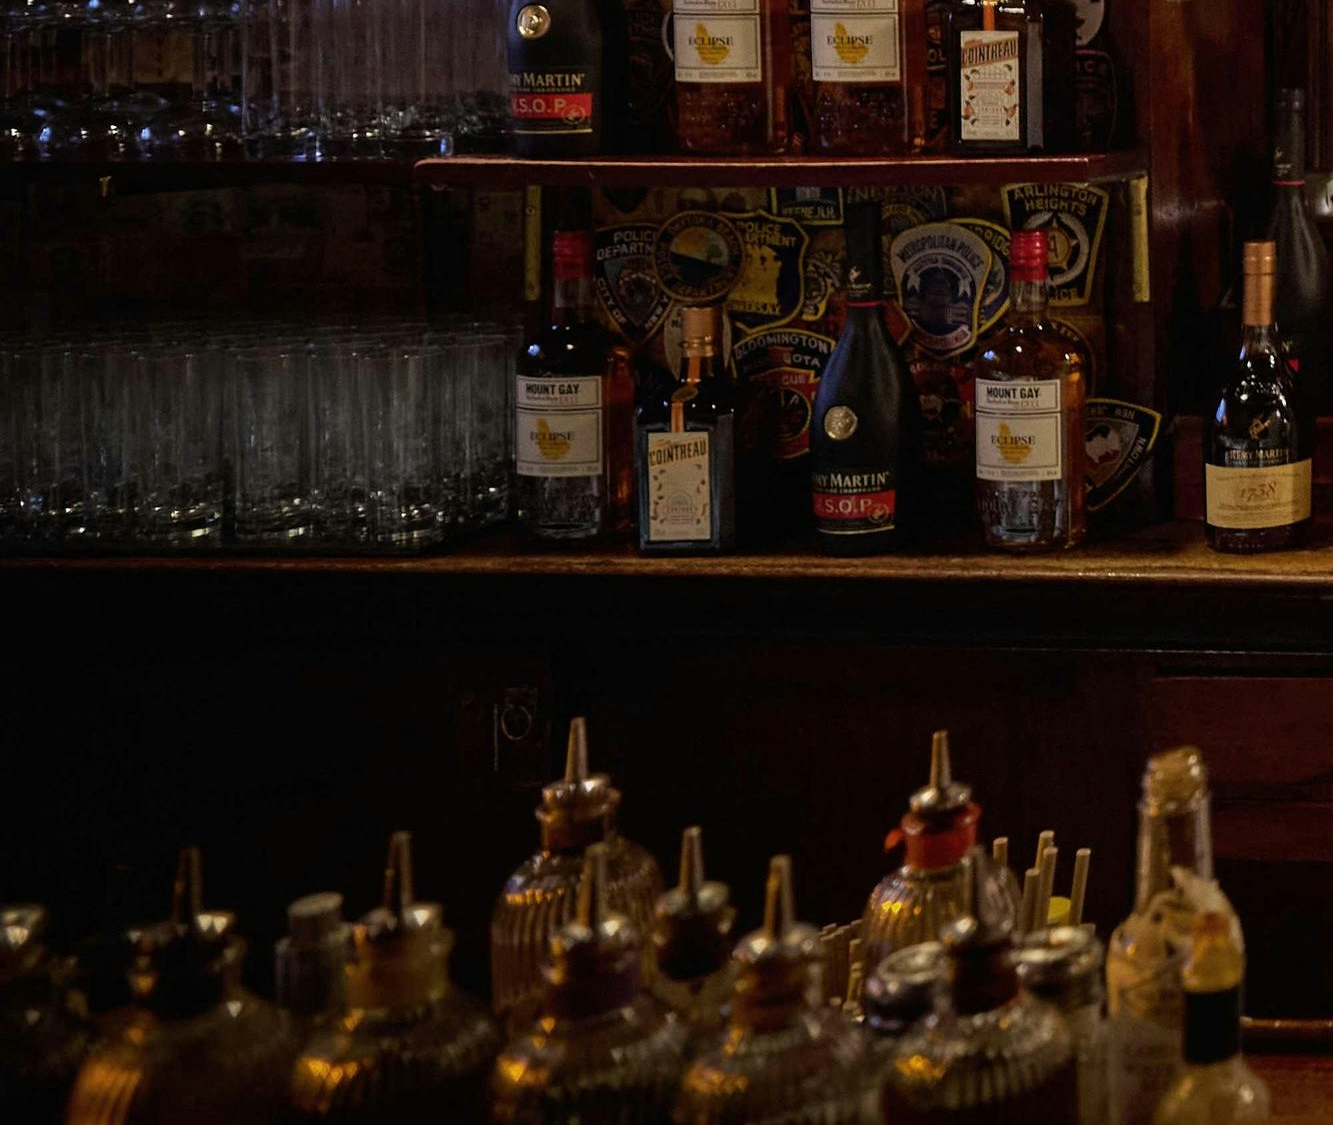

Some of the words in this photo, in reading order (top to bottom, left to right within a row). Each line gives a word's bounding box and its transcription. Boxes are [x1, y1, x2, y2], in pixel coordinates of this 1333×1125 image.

[688, 34, 735, 47] ECLIPSE
[826, 34, 874, 47] ECLIPSE
[961, 40, 1017, 65] COINTREAU
[524, 71, 585, 89] MARTIN
[1013, 184, 1098, 205] ARLINGTON
[1024, 196, 1088, 217] HEIGHTS
[733, 332, 832, 360] BLOOMINGTON
[525, 383, 556, 396] MOUNT
[557, 383, 580, 396] GAY
[986, 386, 1018, 399] MOUNT
[1019, 386, 1040, 399] GAY
[530, 430, 576, 443] ECLIPSE
[990, 434, 1036, 446] ECLIPSE
[648, 439, 708, 466] COINTREAU
[830, 470, 889, 487] MARTIN
[1239, 480, 1278, 502] 1738
